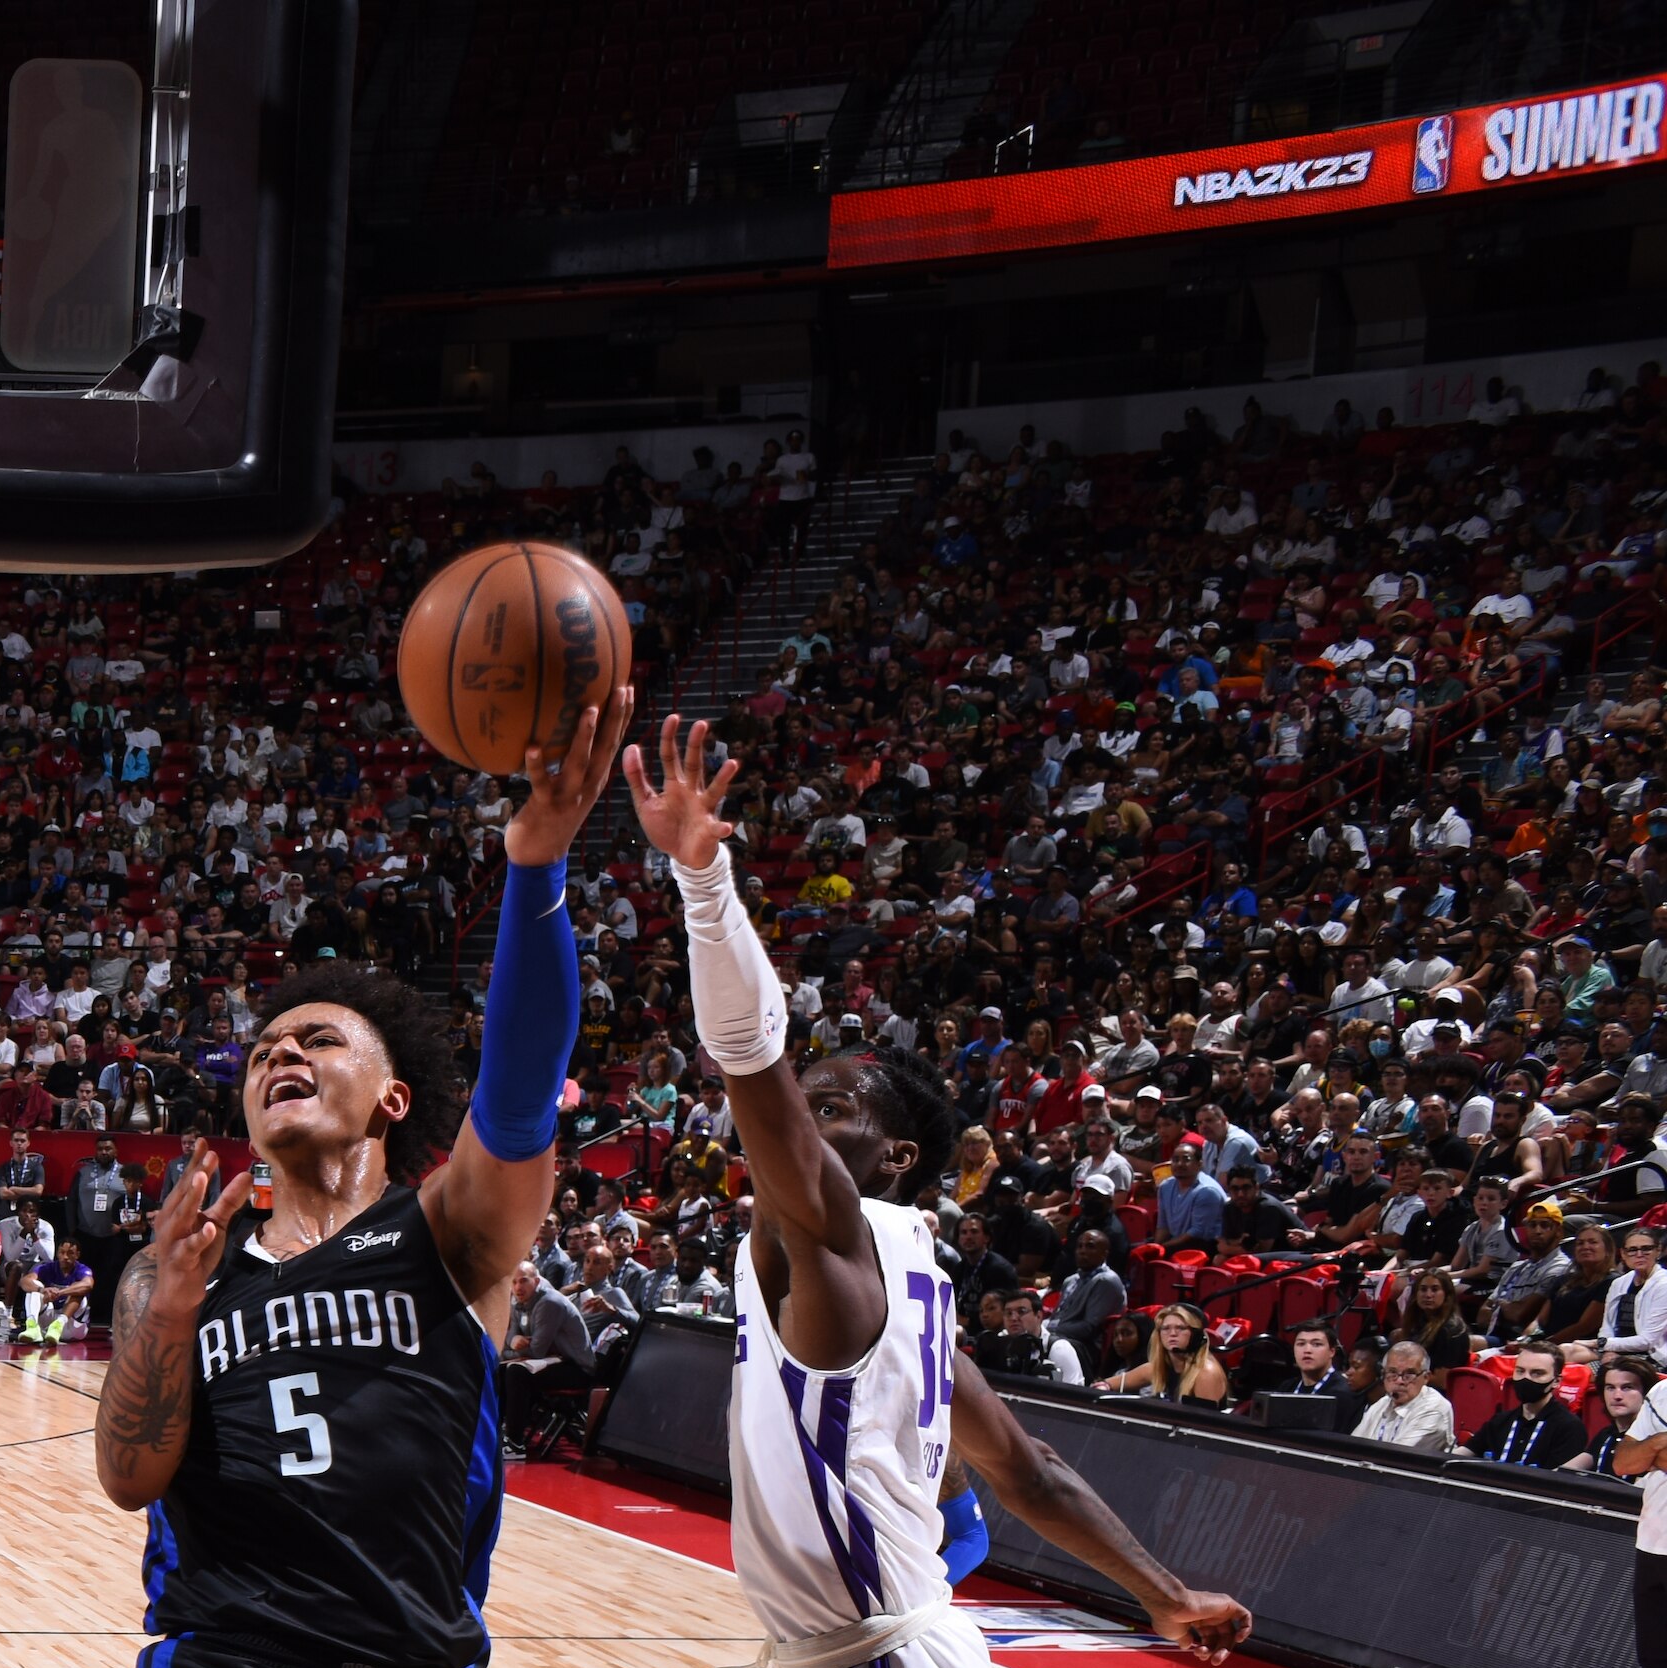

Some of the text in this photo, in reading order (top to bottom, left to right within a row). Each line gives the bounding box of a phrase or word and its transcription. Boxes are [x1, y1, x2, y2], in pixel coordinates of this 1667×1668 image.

[1173, 150, 1374, 206] NBA2K23
[1482, 80, 1665, 182] SUMMER
[199, 1288, 421, 1383] RLANDO
[268, 1371, 333, 1477] 5
